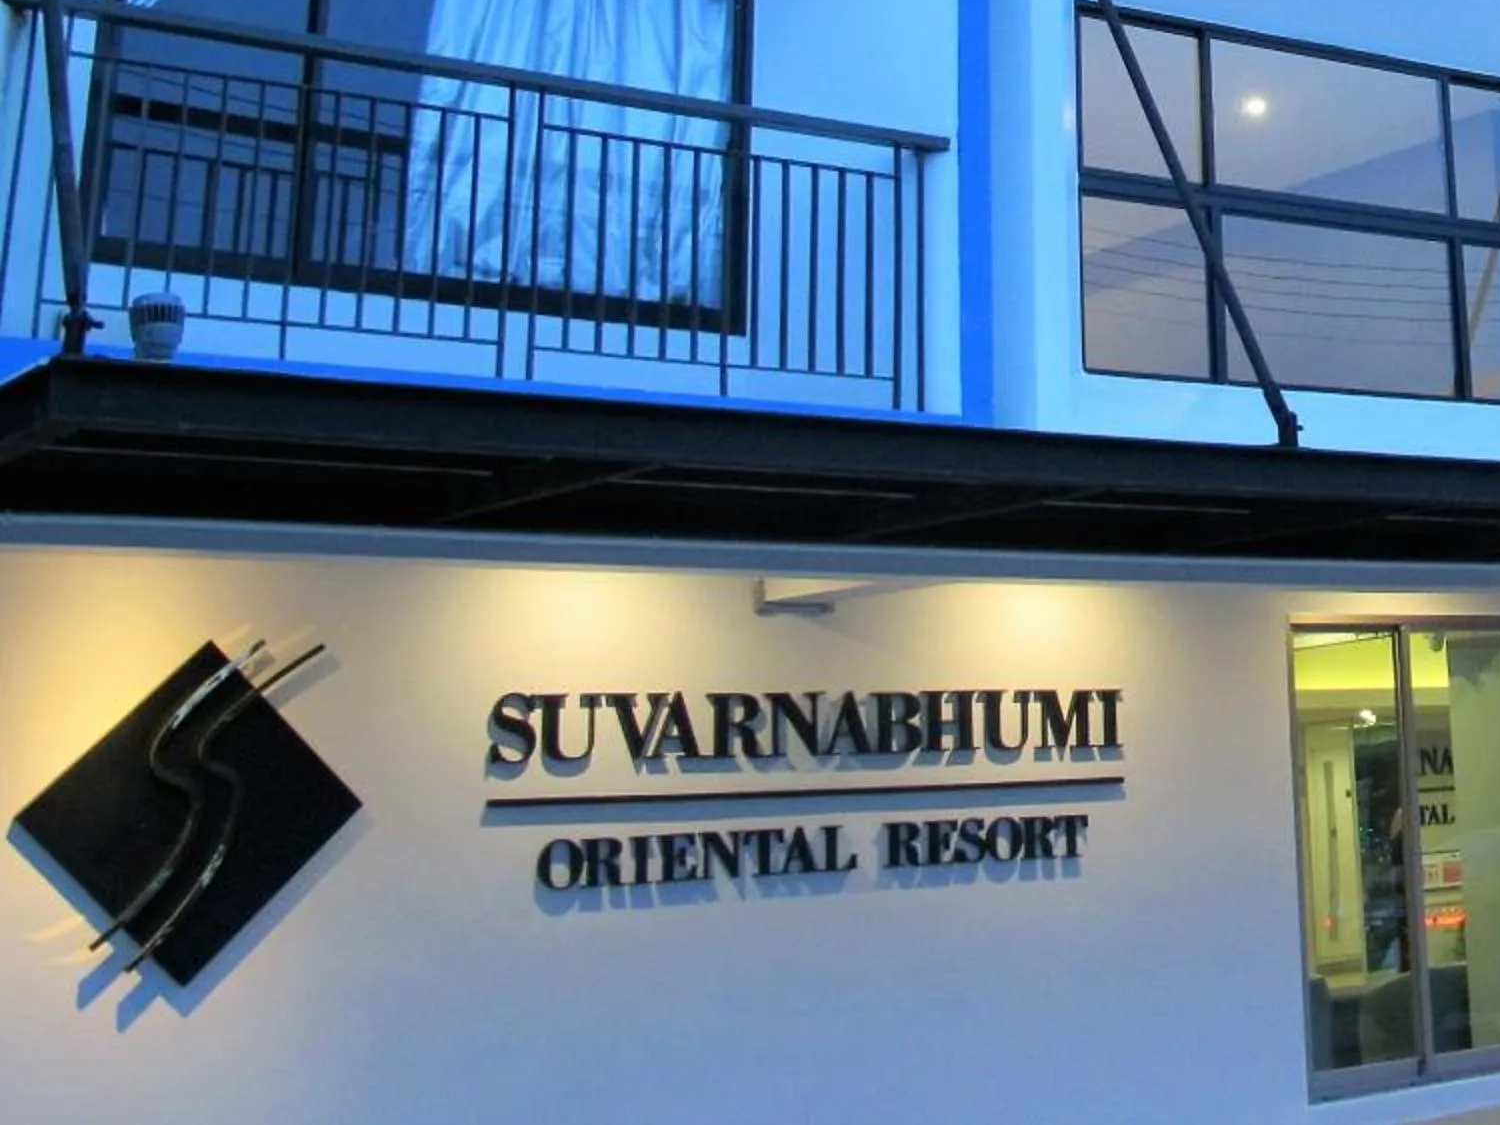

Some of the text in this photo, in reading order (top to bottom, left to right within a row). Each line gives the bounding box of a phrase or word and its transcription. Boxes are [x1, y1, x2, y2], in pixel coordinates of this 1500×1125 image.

[487, 688, 1123, 764] SUVARNABHUMI
[536, 814, 1089, 891] ORIENTAL RESORT
